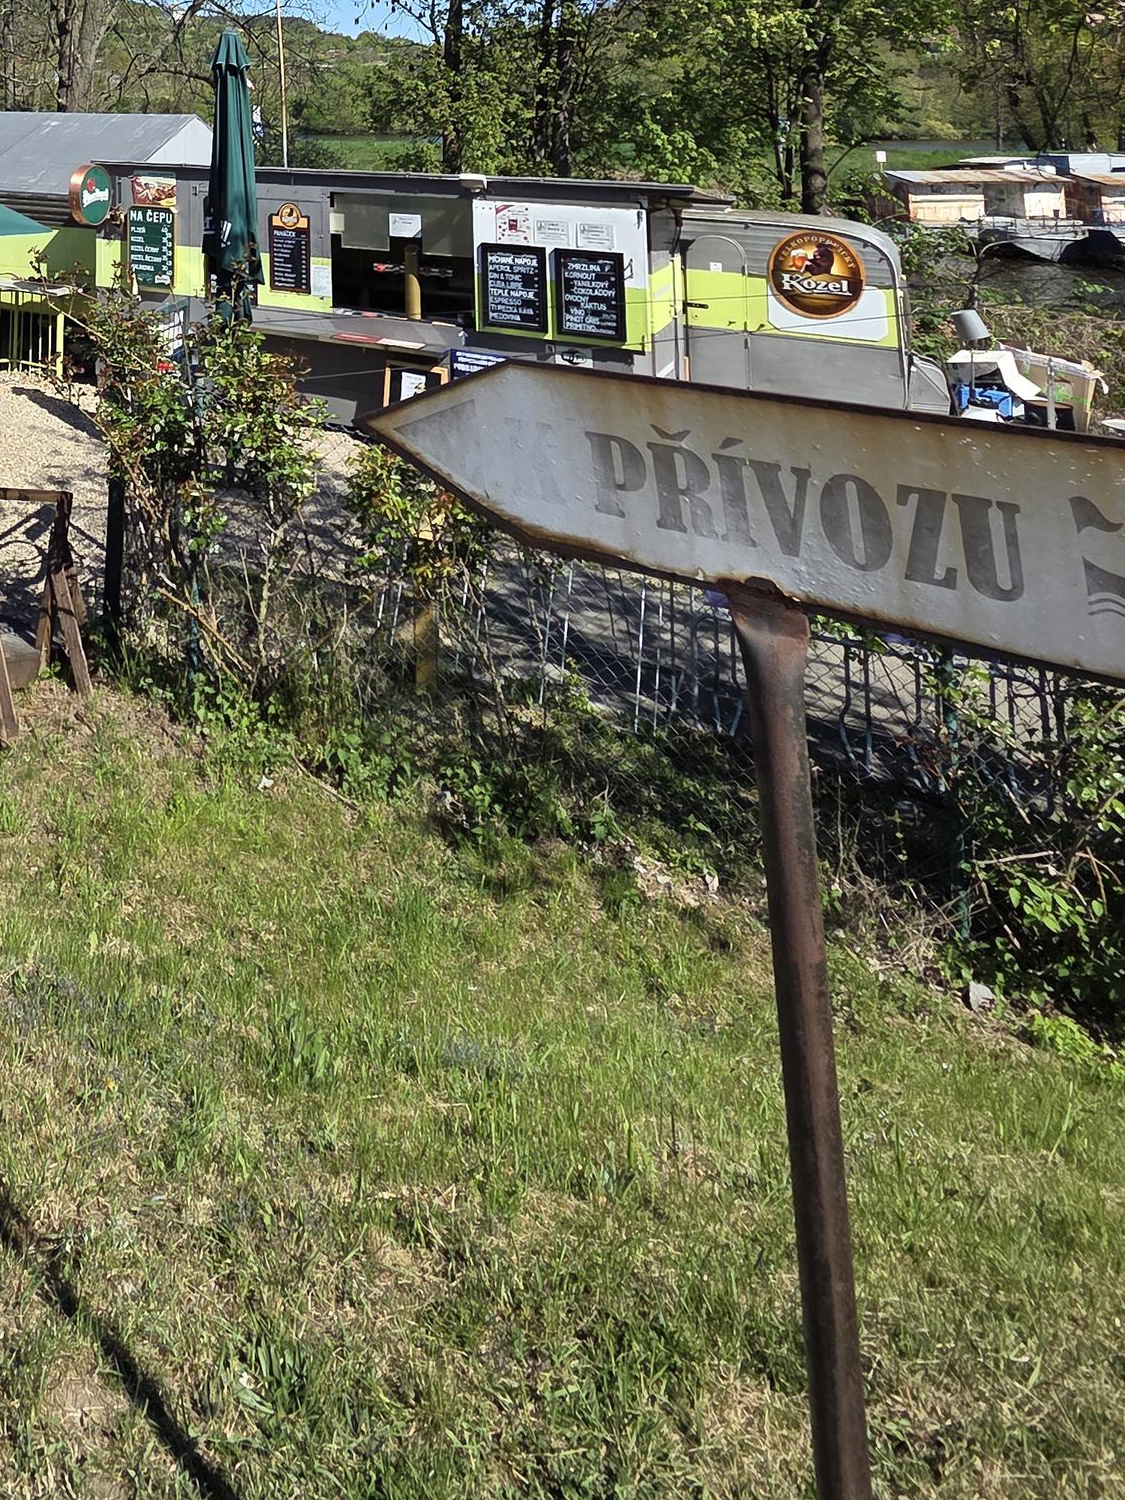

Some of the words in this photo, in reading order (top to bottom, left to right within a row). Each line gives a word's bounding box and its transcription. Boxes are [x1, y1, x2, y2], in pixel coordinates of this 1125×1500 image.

[130, 210, 143, 222] NA
[146, 209, 172, 224] ČEPU
[781, 273, 853, 296] Kozel
[584, 423, 1025, 602] PŘÍVOZU
